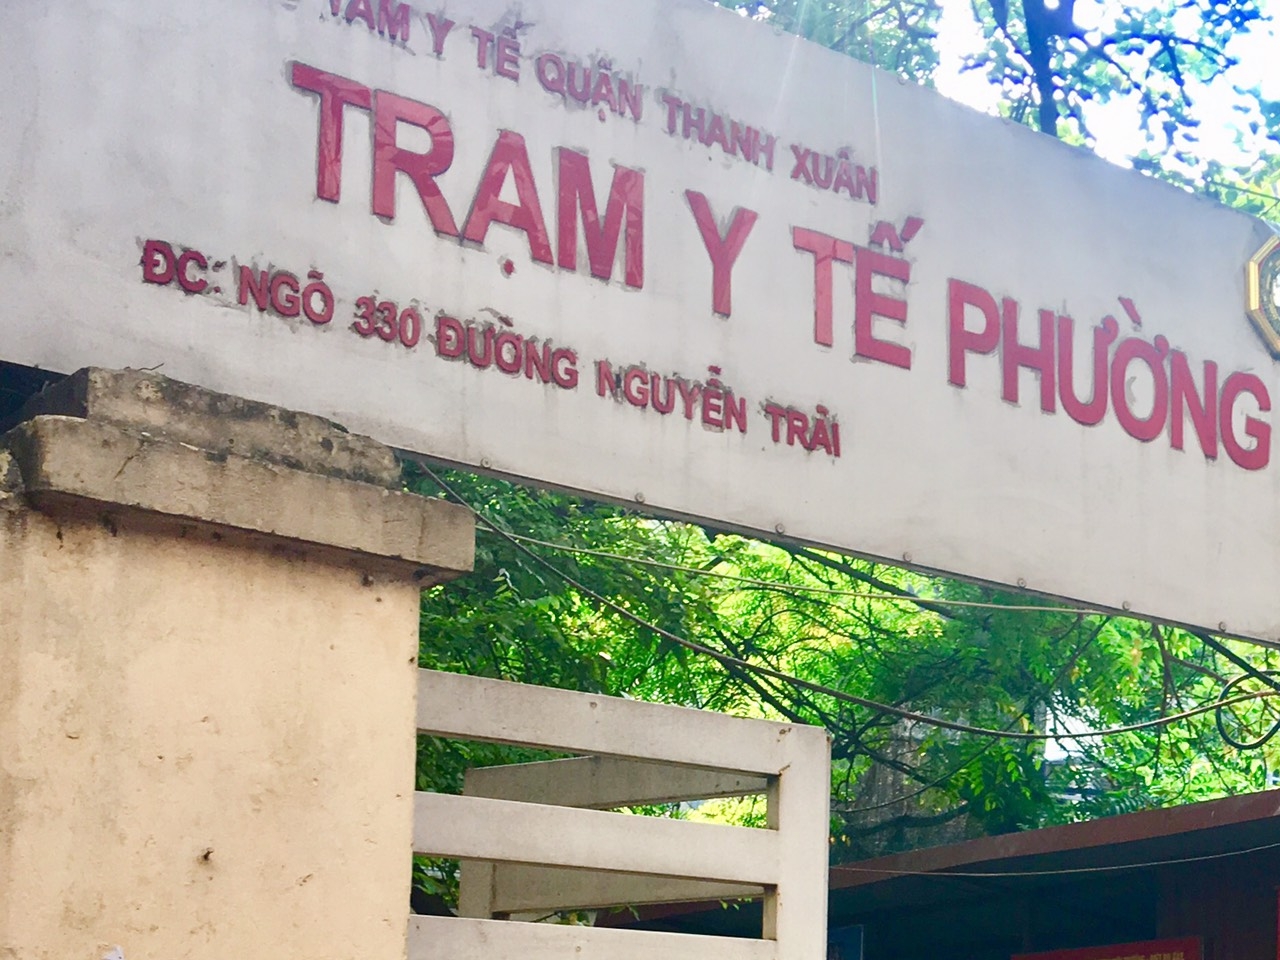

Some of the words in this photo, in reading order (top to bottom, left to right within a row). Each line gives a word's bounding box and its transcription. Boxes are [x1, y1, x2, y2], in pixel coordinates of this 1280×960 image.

[426, 13, 455, 55] Y
[469, 21, 526, 82] TẾ
[536, 53, 643, 122] QUẬN
[661, 92, 776, 171] THANH
[790, 144, 877, 205] XUÂN
[237, 264, 335, 324] NGÕ
[354, 296, 421, 347] 330
[292, 60, 644, 290] TRẠM
[685, 189, 758, 318] Y
[792, 216, 924, 371] TẾ
[947, 278, 1272, 471] PHƯỜNG
